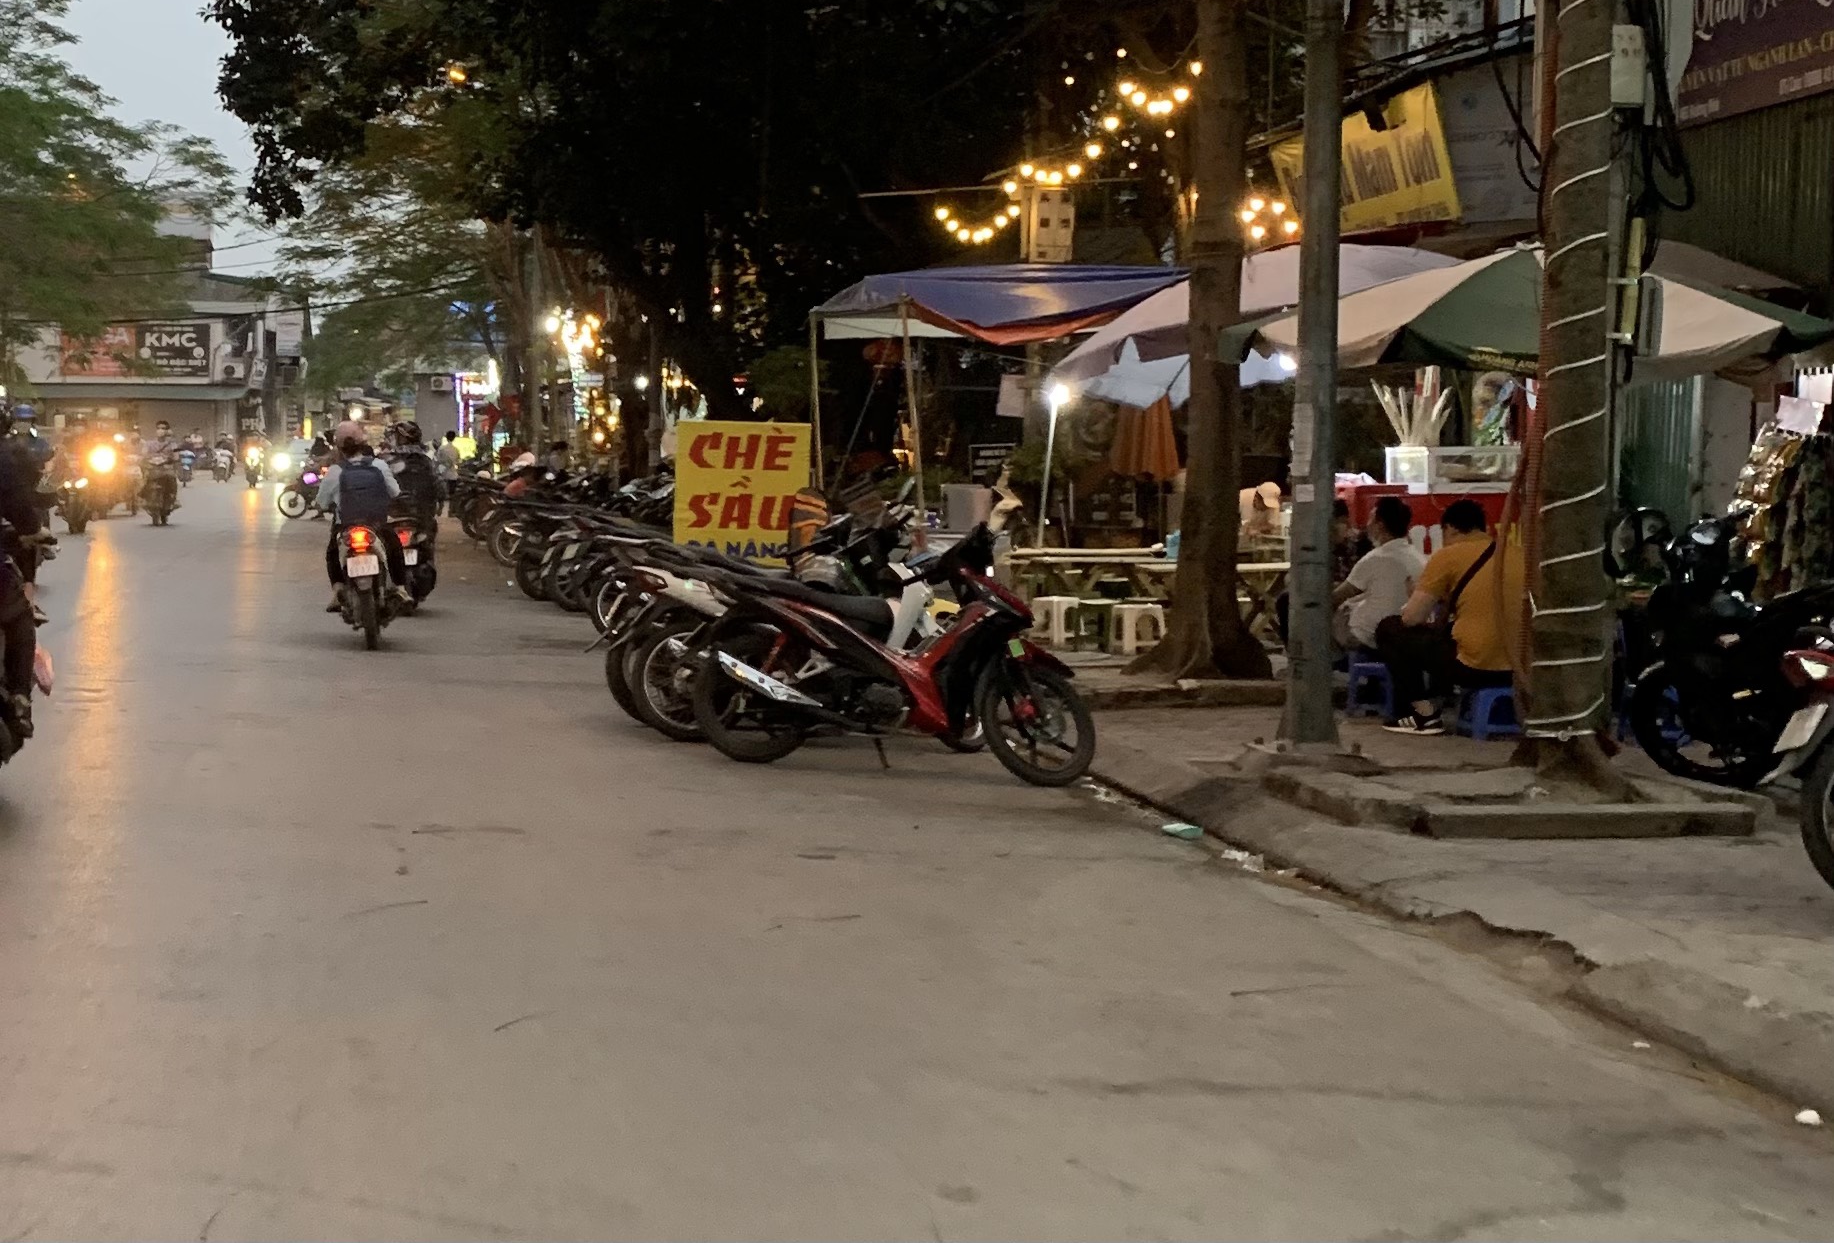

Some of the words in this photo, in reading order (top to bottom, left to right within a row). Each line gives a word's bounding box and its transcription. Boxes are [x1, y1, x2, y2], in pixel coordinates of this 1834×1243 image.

[144, 332, 198, 347] KMC
[688, 426, 797, 471] CHÈ
[687, 475, 797, 531] SẦU
